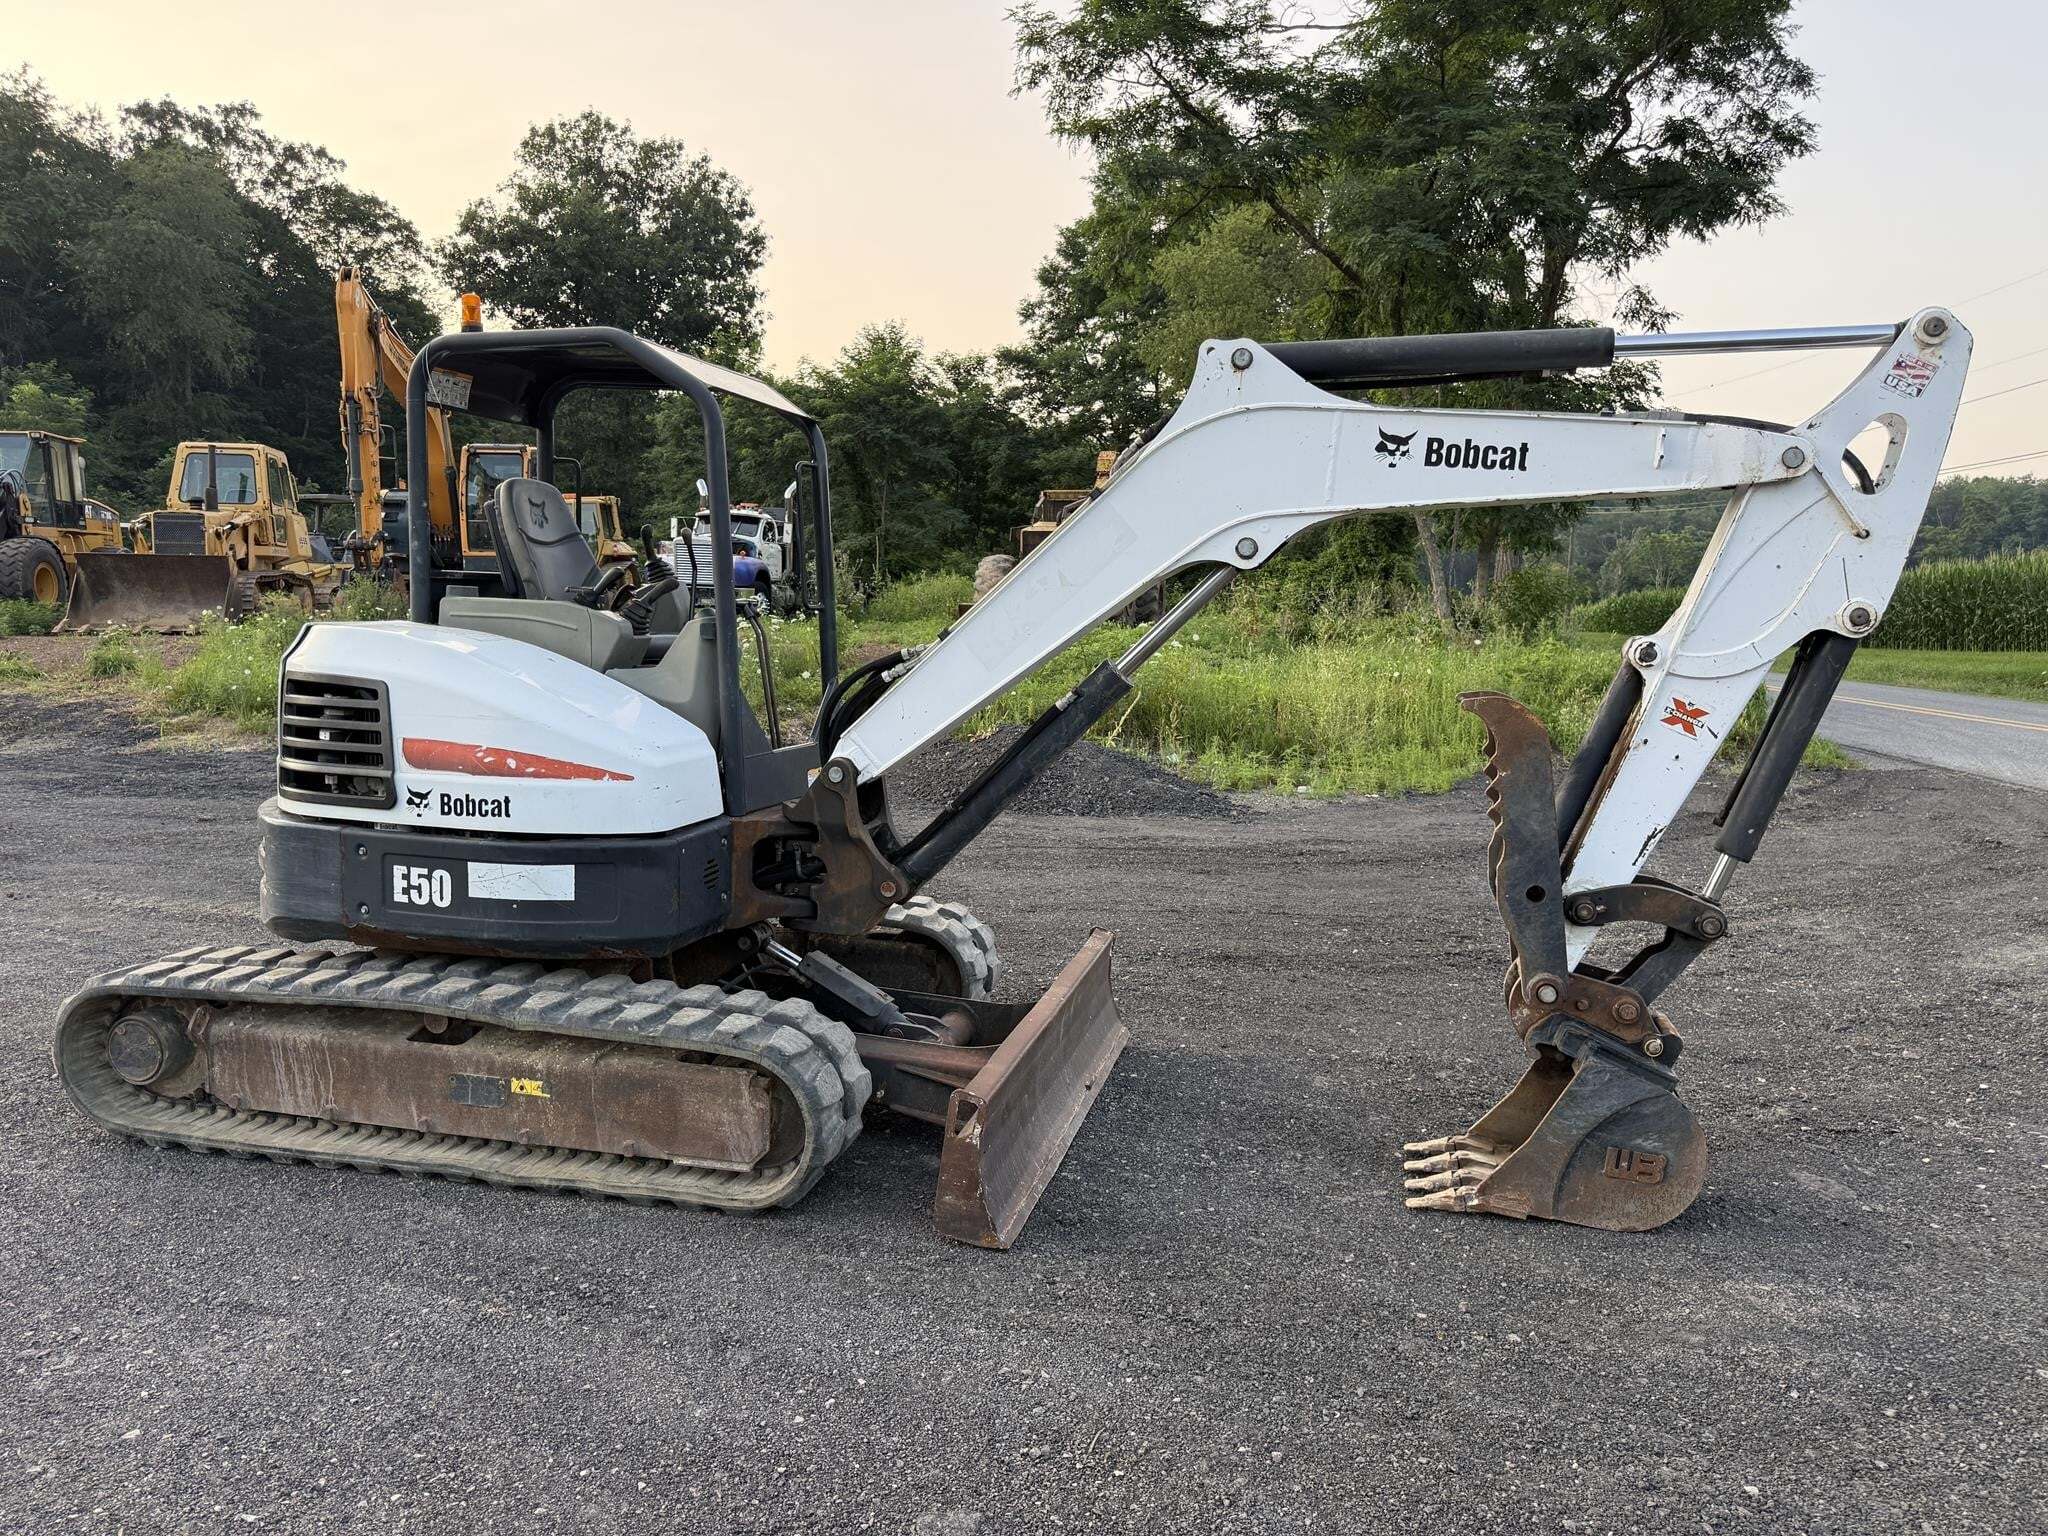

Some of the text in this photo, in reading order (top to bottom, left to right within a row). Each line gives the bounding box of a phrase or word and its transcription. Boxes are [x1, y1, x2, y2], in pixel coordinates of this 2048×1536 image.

[1885, 375, 1919, 398] USA
[1424, 437, 1529, 471] Bobcat
[85, 504, 93, 519] AT
[440, 793, 511, 818] Bobcat
[393, 865, 452, 908] E50
